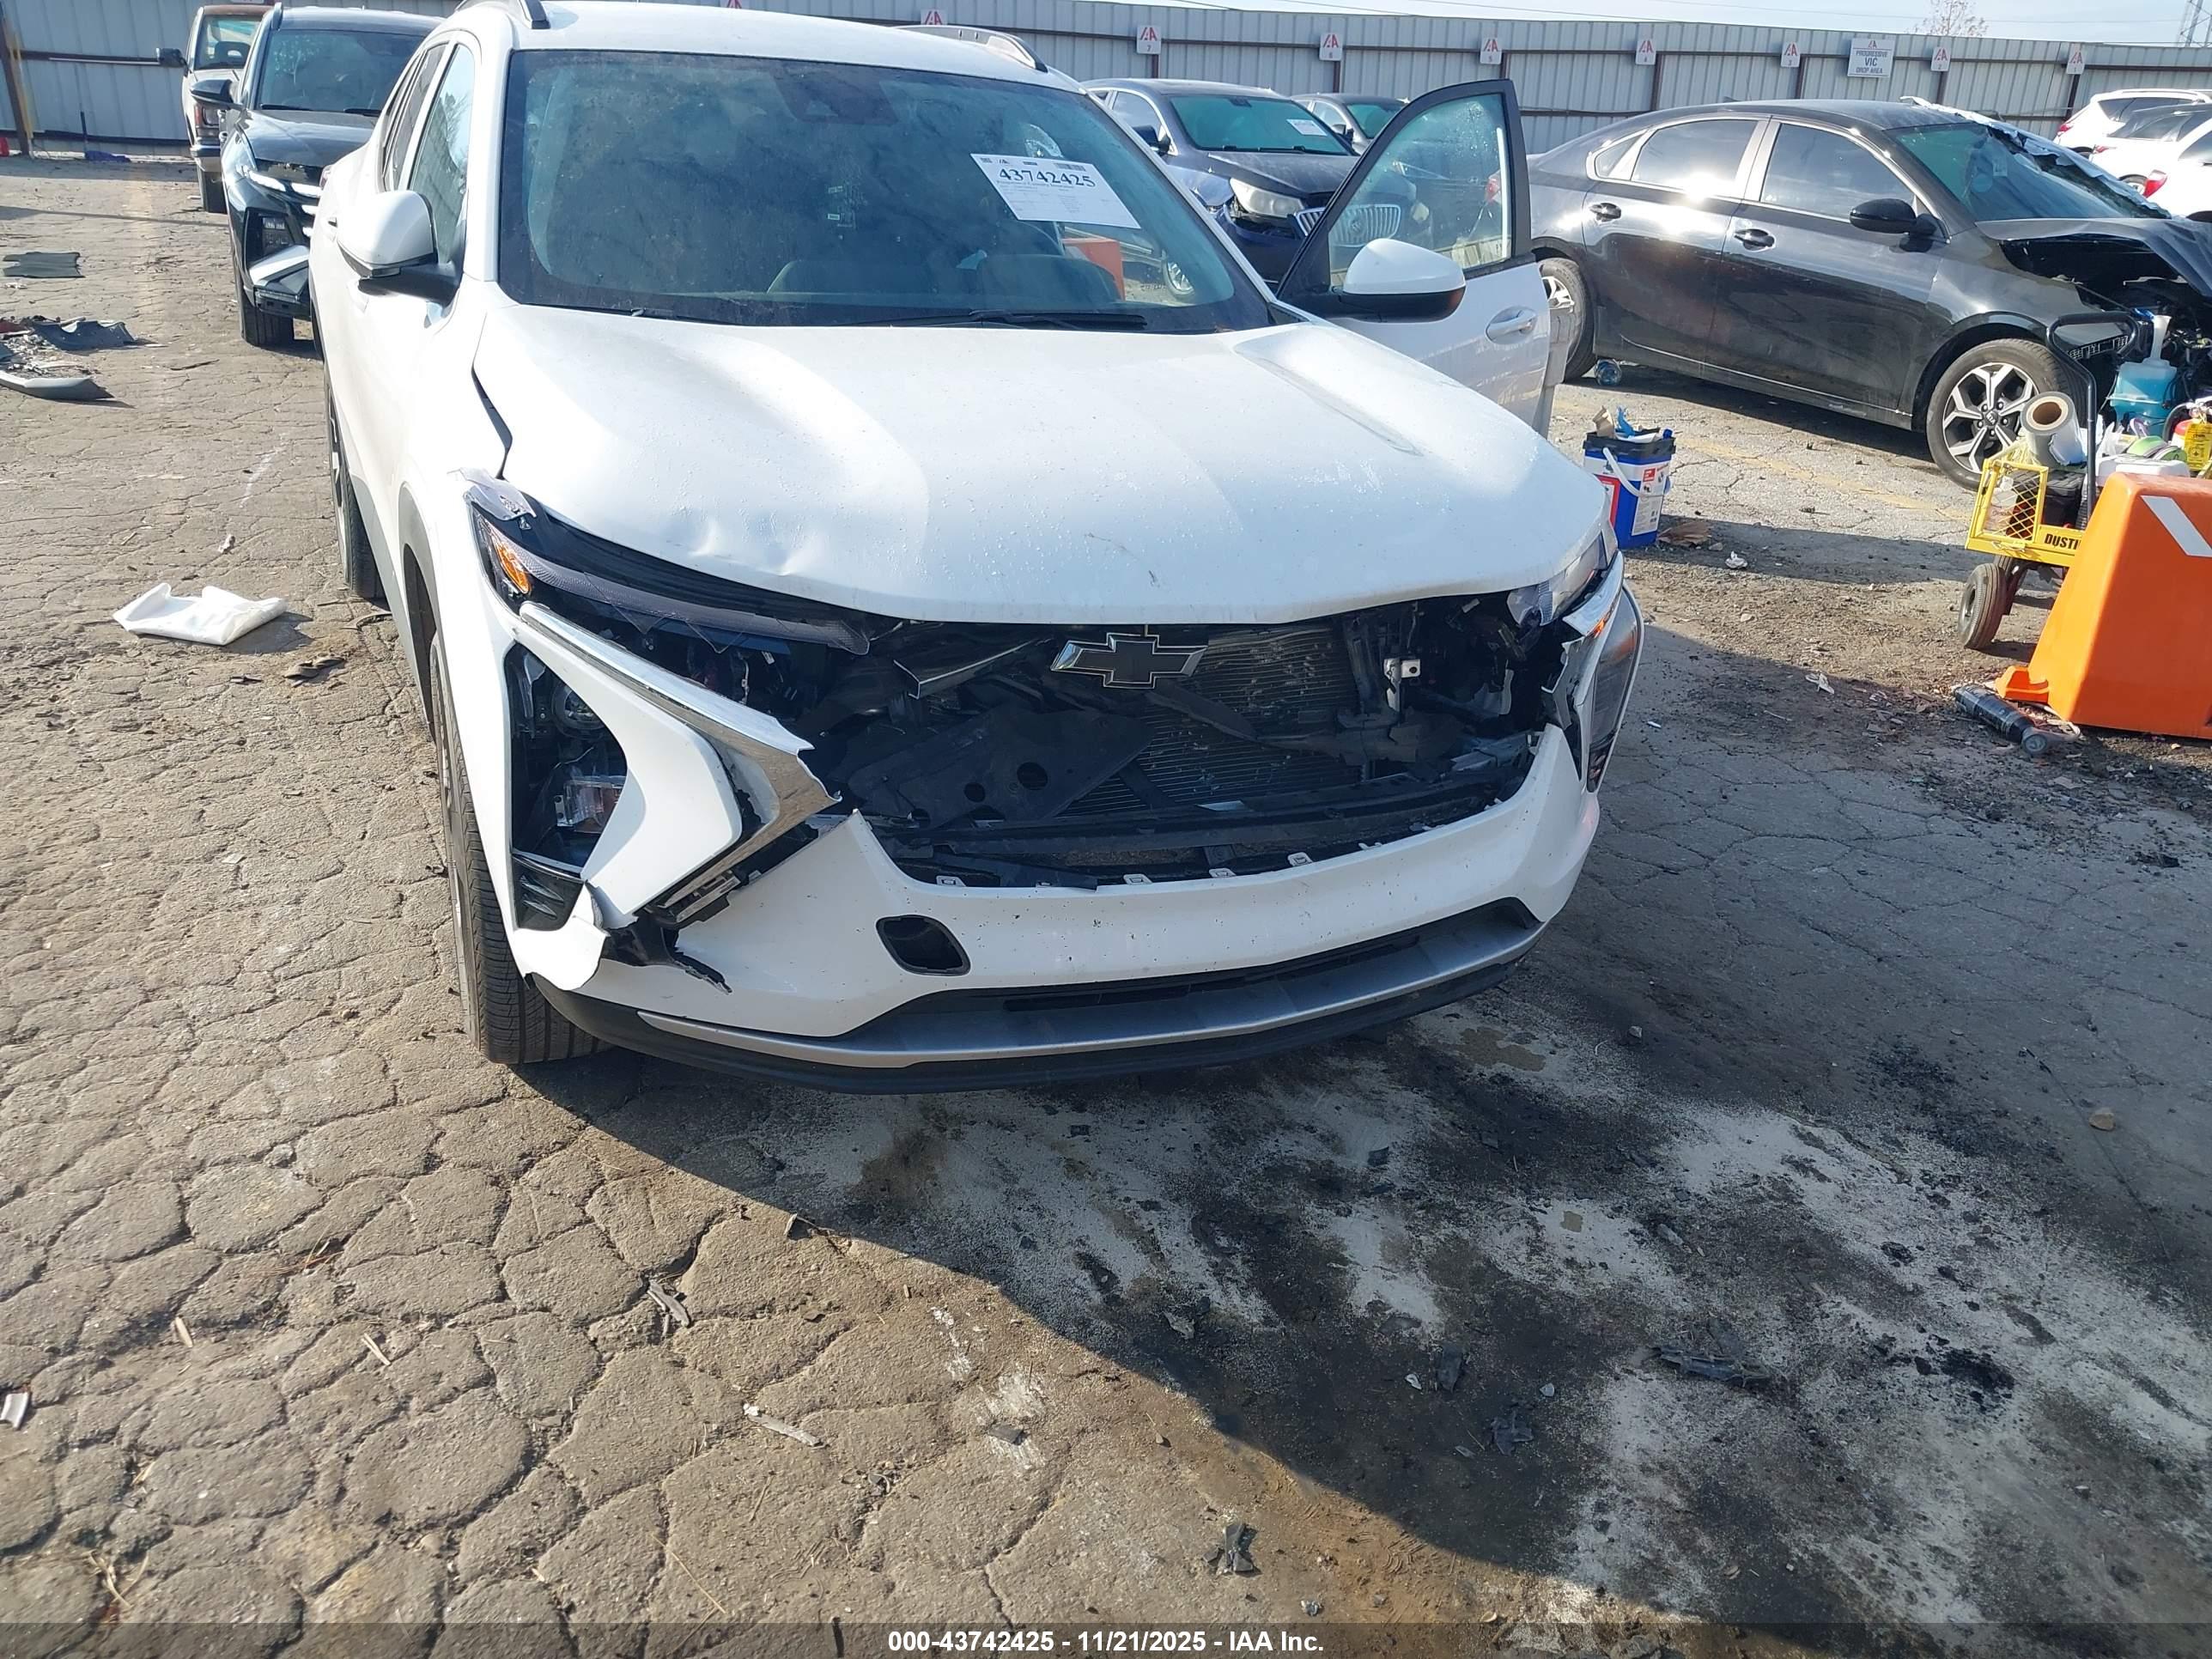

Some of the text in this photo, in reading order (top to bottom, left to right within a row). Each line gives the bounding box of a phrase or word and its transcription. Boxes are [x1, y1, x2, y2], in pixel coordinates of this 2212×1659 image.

[1864, 57, 1878, 67] VIC
[1000, 168, 1097, 187] 43742425
[2044, 533, 2081, 550] DUSTI
